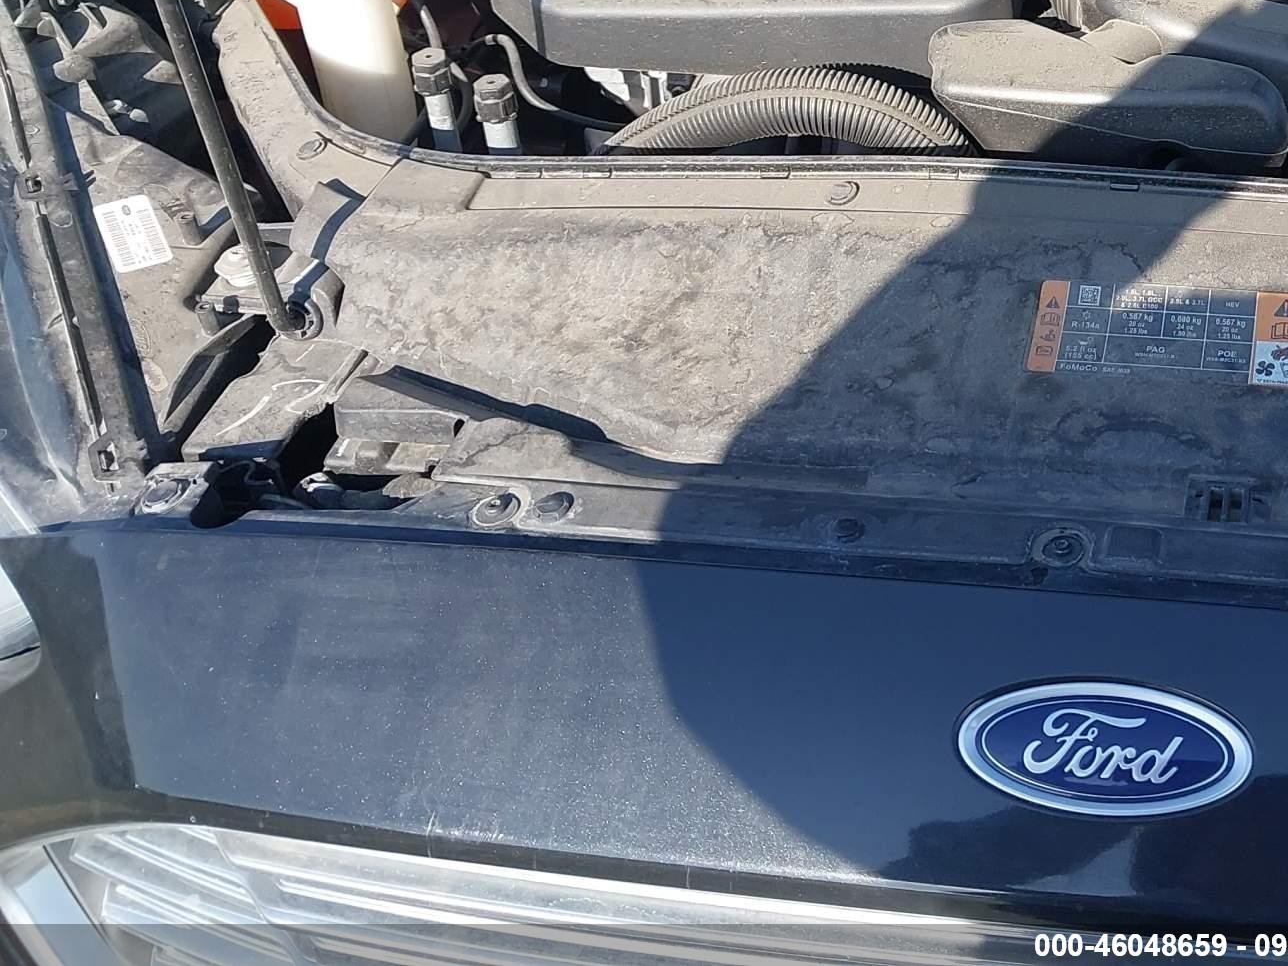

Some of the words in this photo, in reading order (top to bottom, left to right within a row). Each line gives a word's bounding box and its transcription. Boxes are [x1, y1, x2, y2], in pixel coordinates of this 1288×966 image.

[1071, 321, 1100, 329] R-134a
[1192, 317, 1202, 326] kg
[1237, 319, 1246, 329] kg
[1060, 363, 1098, 371] FoMoCo
[1023, 708, 1183, 784] Ford
